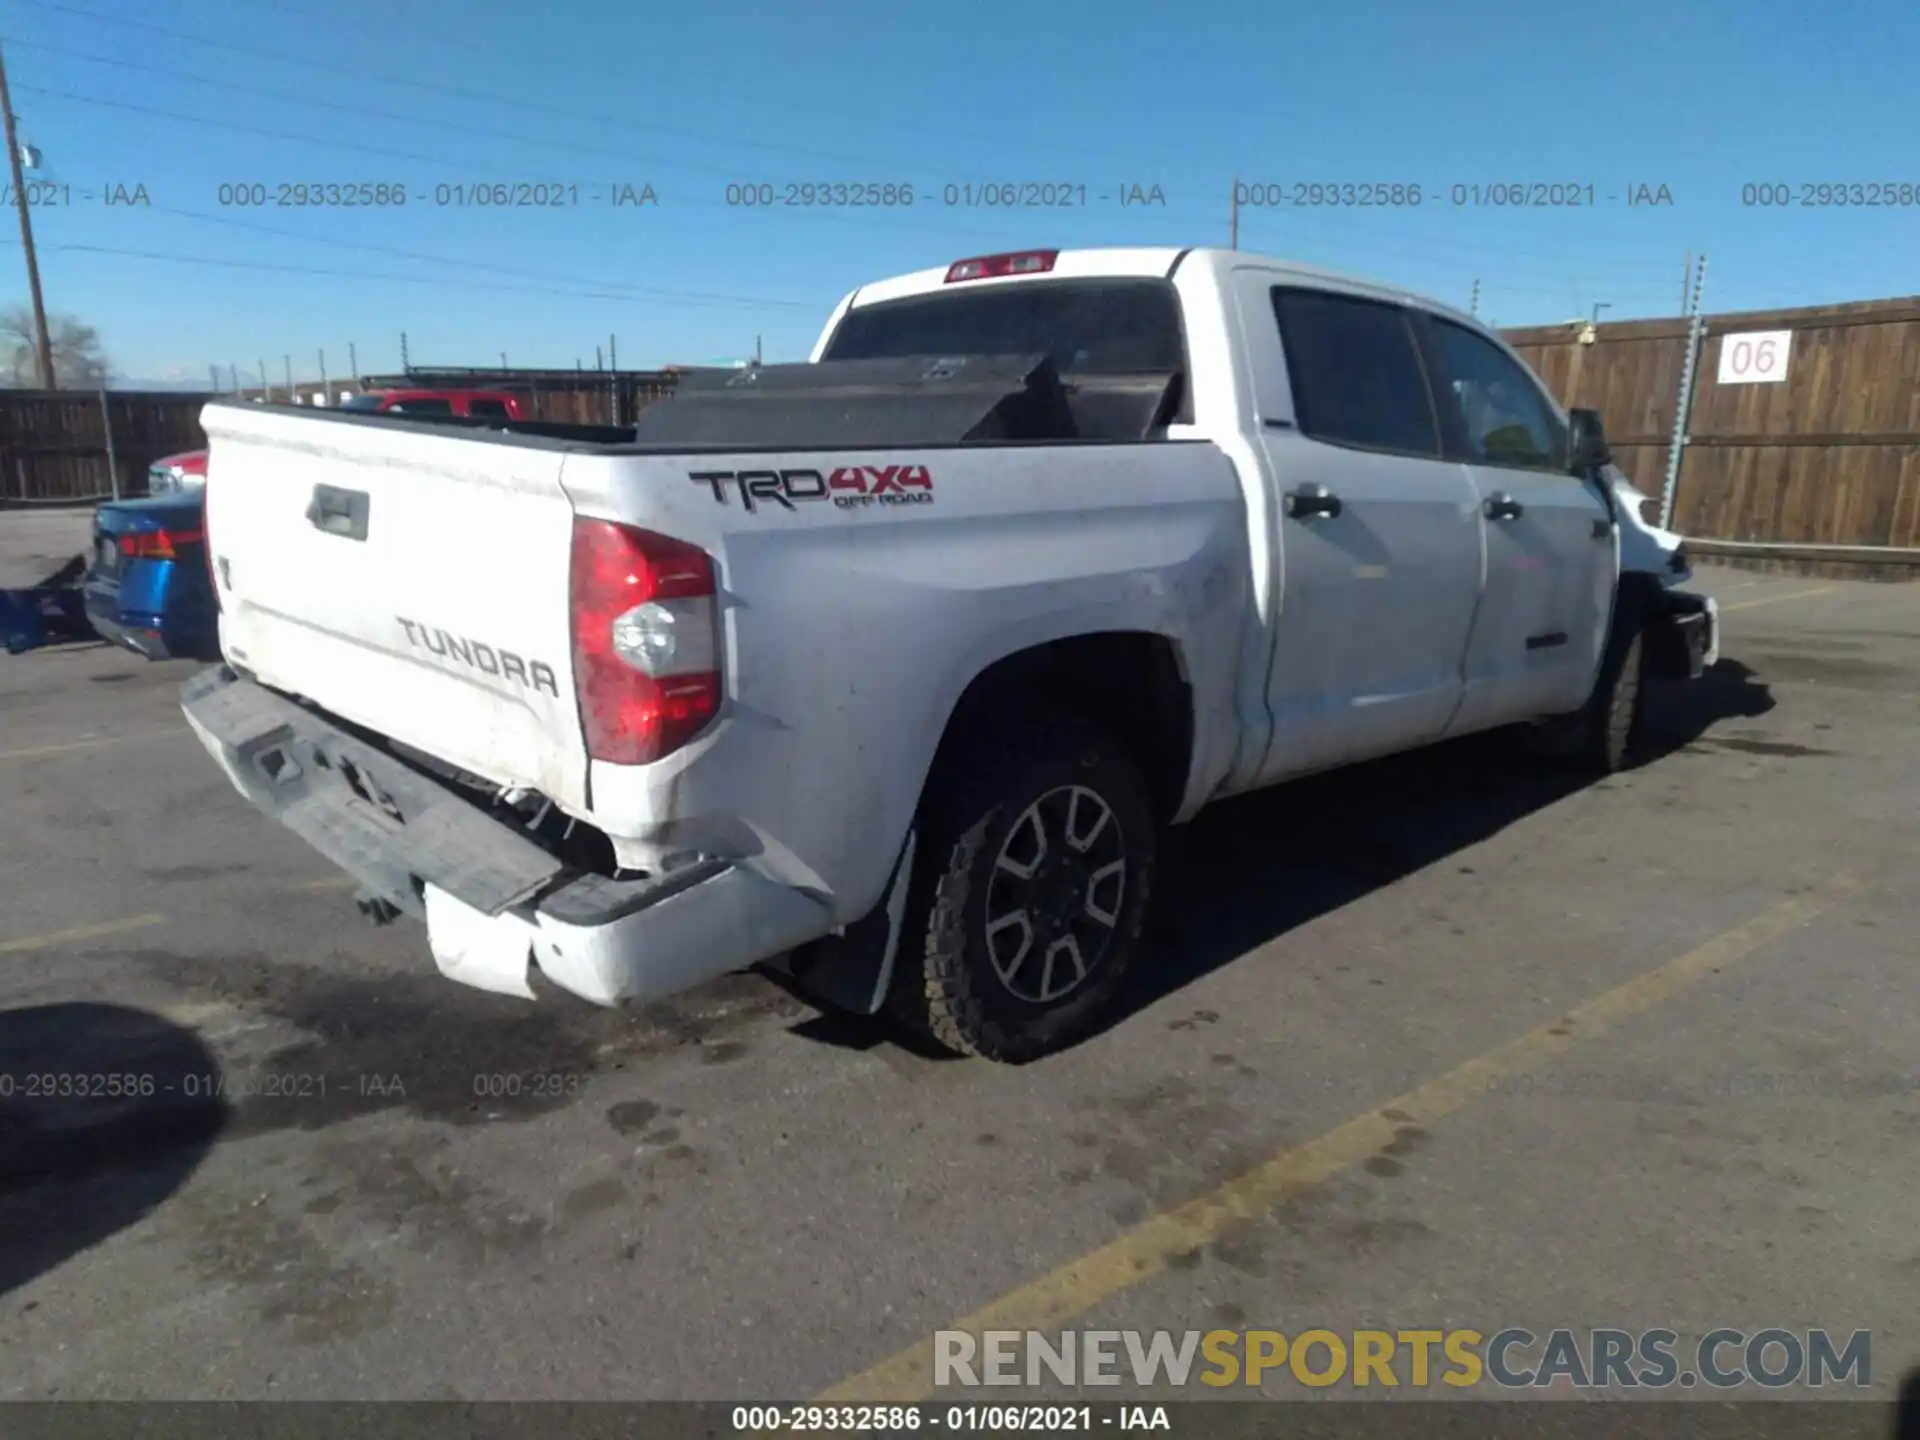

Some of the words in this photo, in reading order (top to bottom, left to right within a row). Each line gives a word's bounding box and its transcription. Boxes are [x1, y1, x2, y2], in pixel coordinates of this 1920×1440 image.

[1732, 340, 1776, 375] 06
[688, 469, 830, 514] TRD
[833, 494, 875, 509] OFF
[878, 491, 934, 507] ROAD
[394, 613, 560, 698] TUNDRA
